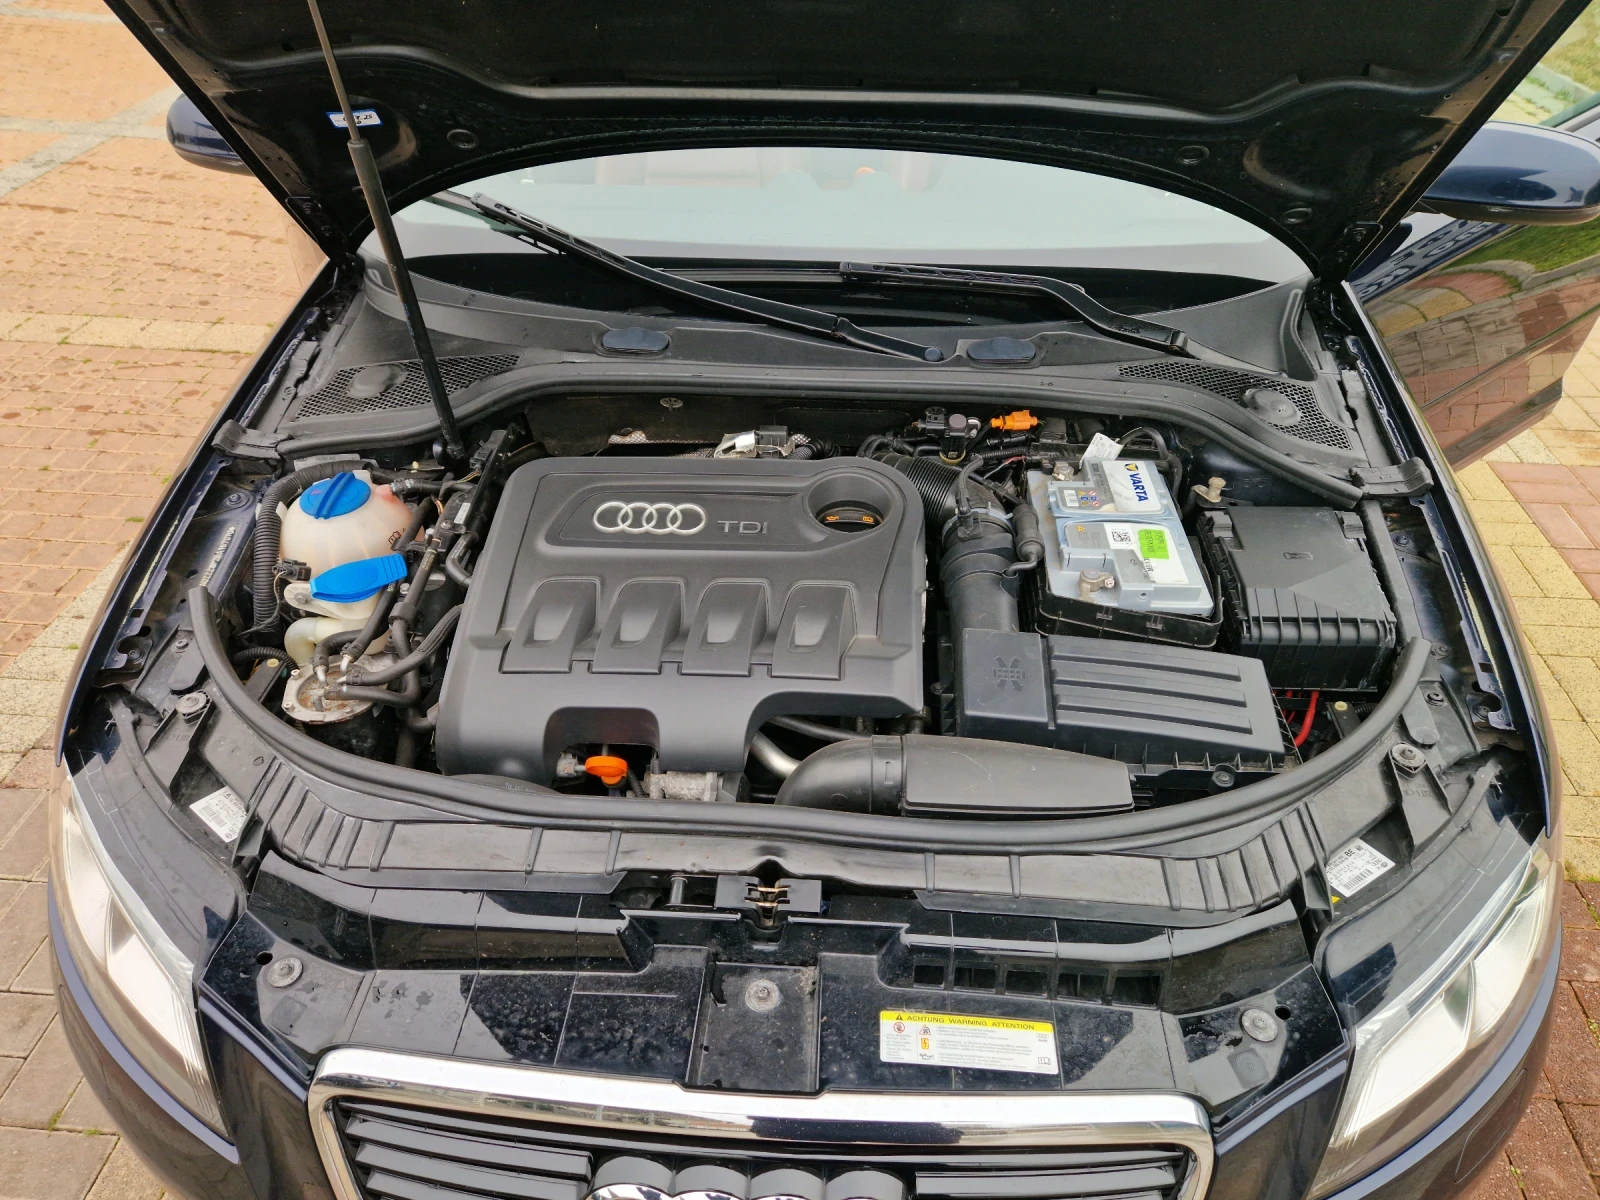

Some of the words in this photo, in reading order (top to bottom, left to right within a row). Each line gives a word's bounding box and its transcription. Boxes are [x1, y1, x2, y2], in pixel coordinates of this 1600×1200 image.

[1129, 473, 1149, 502] VARTA
[717, 520, 768, 534] TDI
[906, 1015, 945, 1024] ACHTUNG
[948, 1018, 988, 1027] WARNING
[991, 1021, 1035, 1030] ATTENTION
